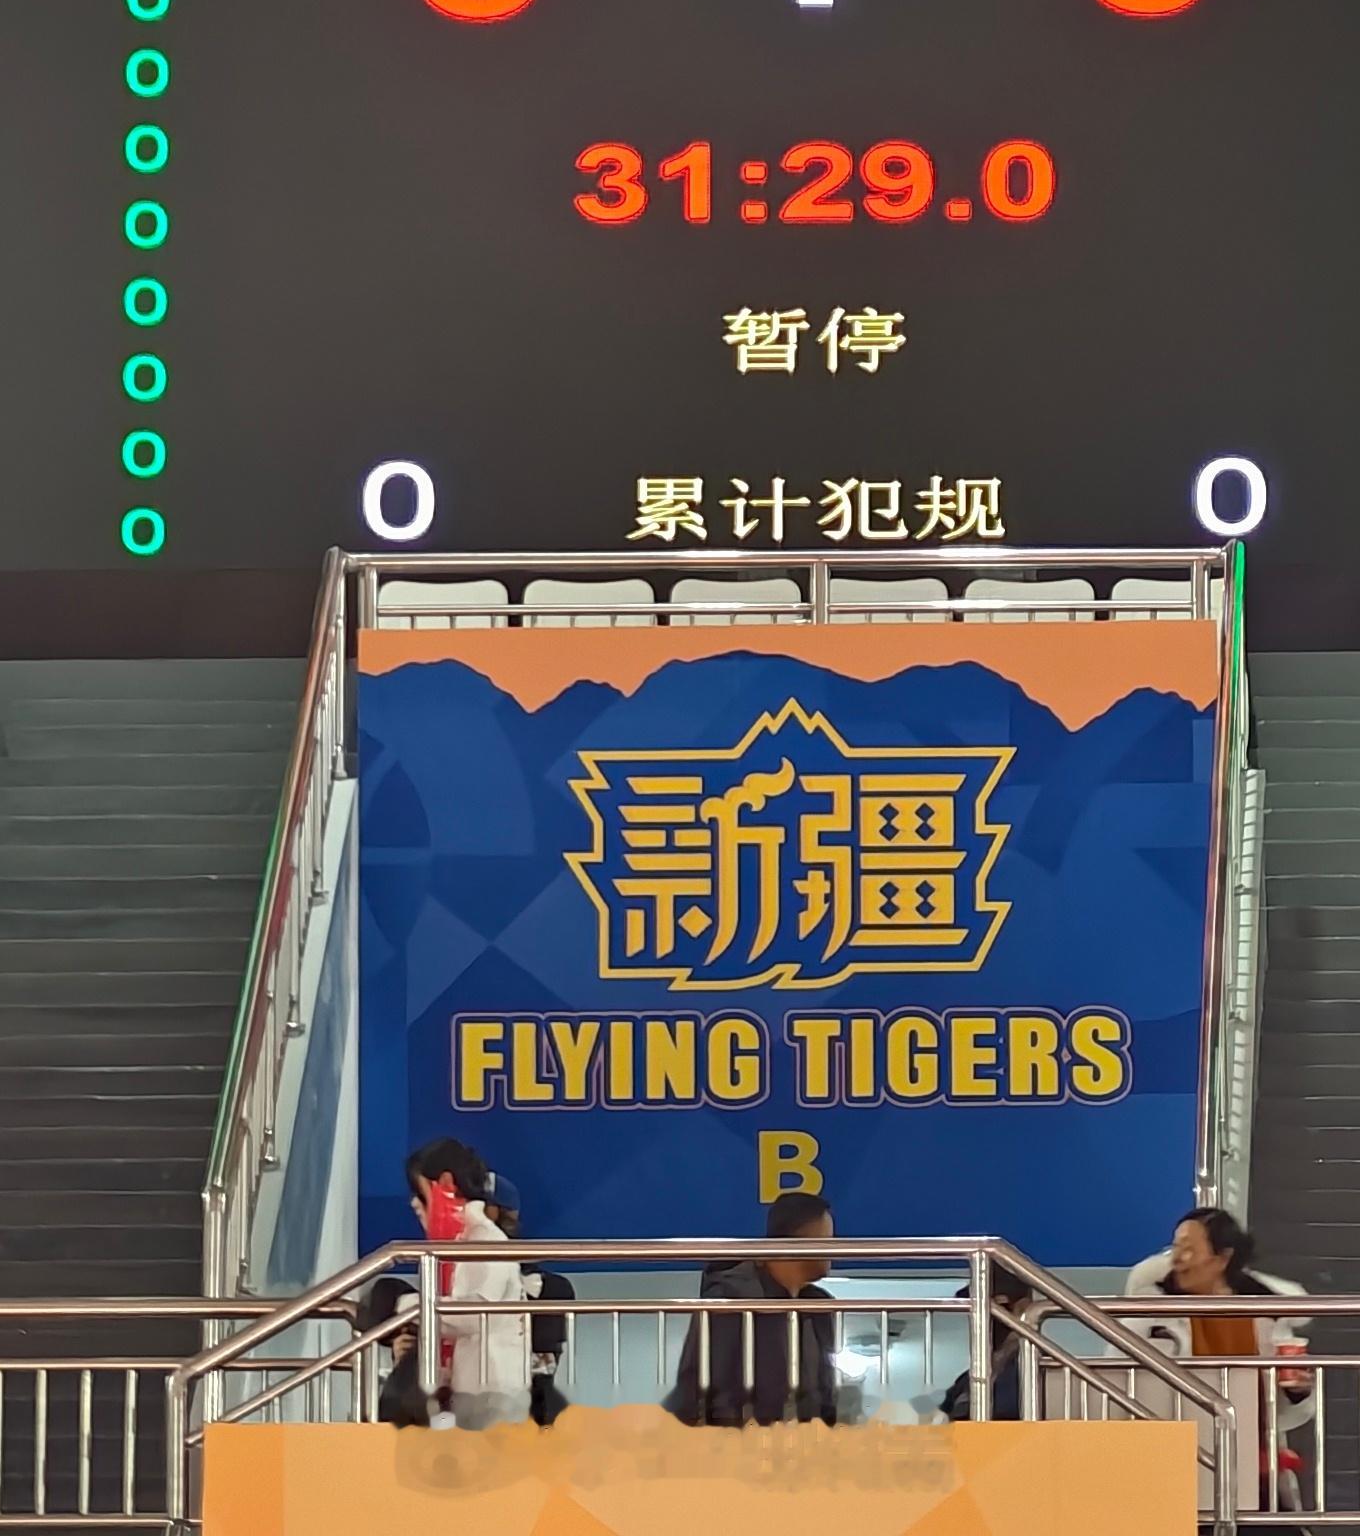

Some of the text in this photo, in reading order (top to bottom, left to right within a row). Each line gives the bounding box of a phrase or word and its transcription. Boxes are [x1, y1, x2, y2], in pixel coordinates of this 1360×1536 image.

[124, 48, 171, 100] 0
[123, 123, 170, 175] 0
[573, 138, 1058, 226] 31:29.0
[123, 199, 170, 251] 0
[122, 276, 169, 328] 0
[723, 307, 907, 374] 暂停
[121, 352, 169, 404] 0
[121, 428, 168, 480] 0
[361, 456, 1268, 541] 0 累计犯规 0
[120, 506, 167, 558] 0
[613, 756, 970, 965] 新疆
[460, 1015, 1124, 1102] FLYING TIGERS
[759, 1131, 823, 1204] B
